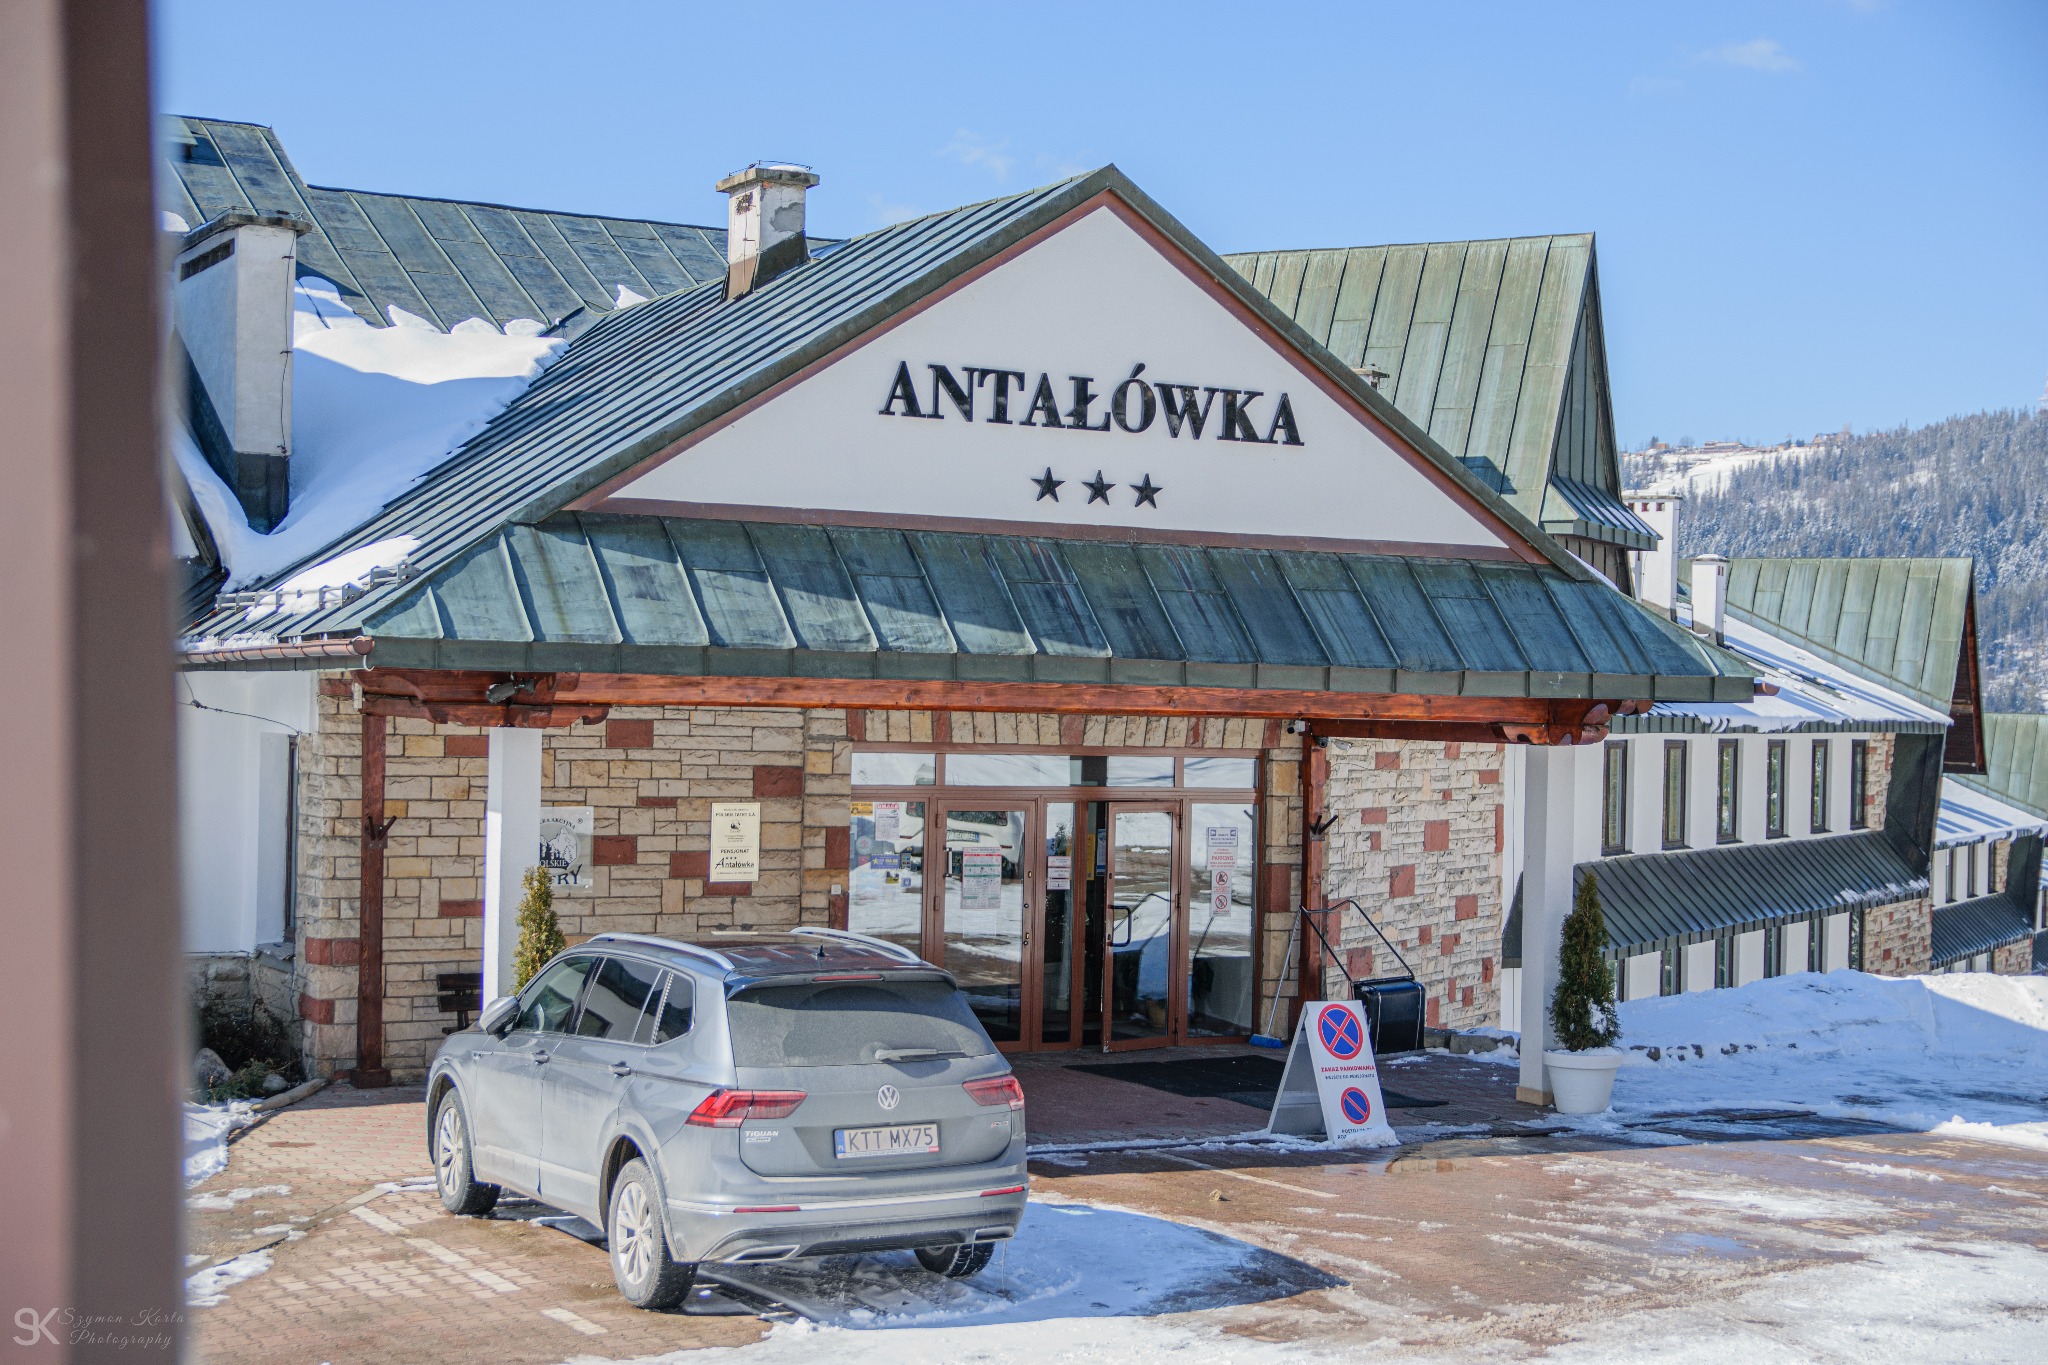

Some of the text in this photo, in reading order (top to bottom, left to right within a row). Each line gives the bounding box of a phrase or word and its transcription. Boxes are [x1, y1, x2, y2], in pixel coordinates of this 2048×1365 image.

[879, 361, 1304, 446] ANTAŁÓWKA
[540, 860, 568, 868] OLSKIE
[1340, 1064, 1375, 1072] PARKOWANIA
[848, 1127, 934, 1151] KTT MX75
